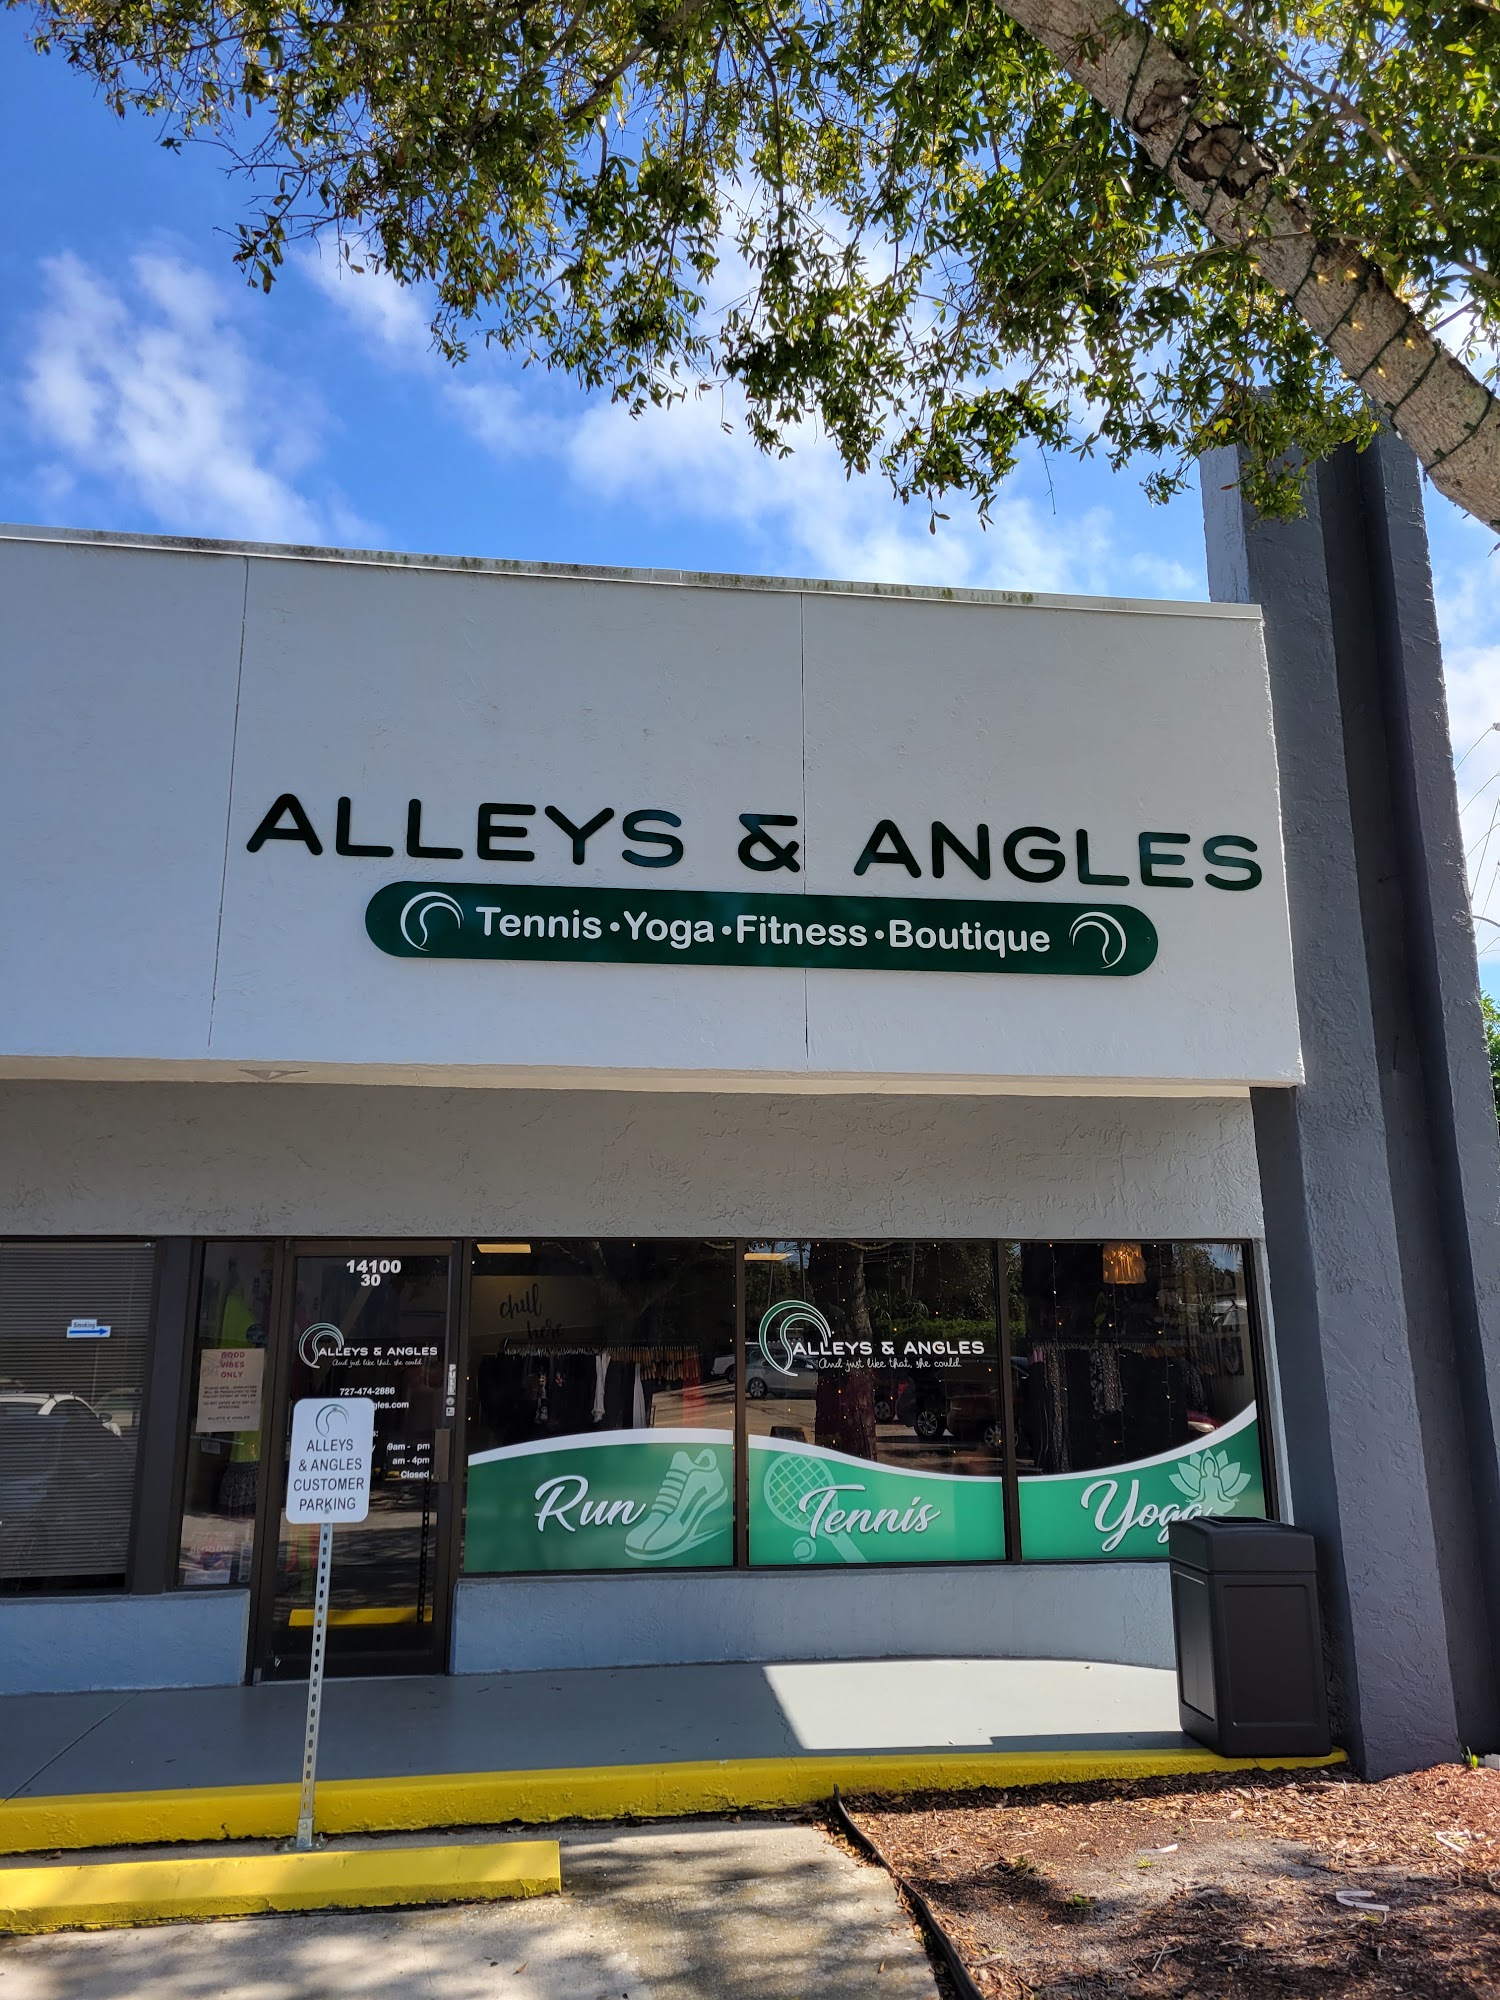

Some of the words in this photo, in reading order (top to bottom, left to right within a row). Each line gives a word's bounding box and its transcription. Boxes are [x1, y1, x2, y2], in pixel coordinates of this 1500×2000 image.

[246, 793, 684, 868] ALLEYS
[737, 813, 801, 873] &
[853, 818, 1262, 892] ANGLES
[475, 906, 602, 940] Tennis
[622, 911, 715, 950] Yoga
[735, 914, 868, 947] Fitness
[888, 919, 1051, 958] Boutique
[346, 1259, 402, 1274] 14100
[360, 1273, 381, 1287] 30
[73, 1321, 96, 1330] Smoking
[221, 1351, 246, 1359] GOOD
[318, 1346, 368, 1357] ALLEYS
[373, 1346, 382, 1356] &
[387, 1346, 438, 1356] ANGLES
[793, 1341, 873, 1356] ALLEYS
[881, 1341, 895, 1355] &
[903, 1341, 985, 1355] ANGLES
[220, 1361, 245, 1369] VIBES
[349, 1358, 361, 1369] just
[362, 1358, 375, 1366] like
[393, 1357, 403, 1366] she
[818, 1357, 843, 1369] And
[843, 1357, 864, 1373] just
[867, 1356, 886, 1369] like
[888, 1356, 913, 1369] that,
[915, 1357, 931, 1369] she
[339, 1387, 396, 1396] 727-474-2886
[306, 1438, 354, 1453] ALLEYS
[298, 1459, 307, 1472] &
[310, 1457, 362, 1472] ANGLES
[412, 1456, 430, 1466] 4pm
[400, 1470, 430, 1479] Closed
[293, 1477, 365, 1492] CUSTOMER
[299, 1497, 356, 1512] PARKING
[534, 1475, 647, 1533] Run
[798, 1484, 941, 1538] Tennis
